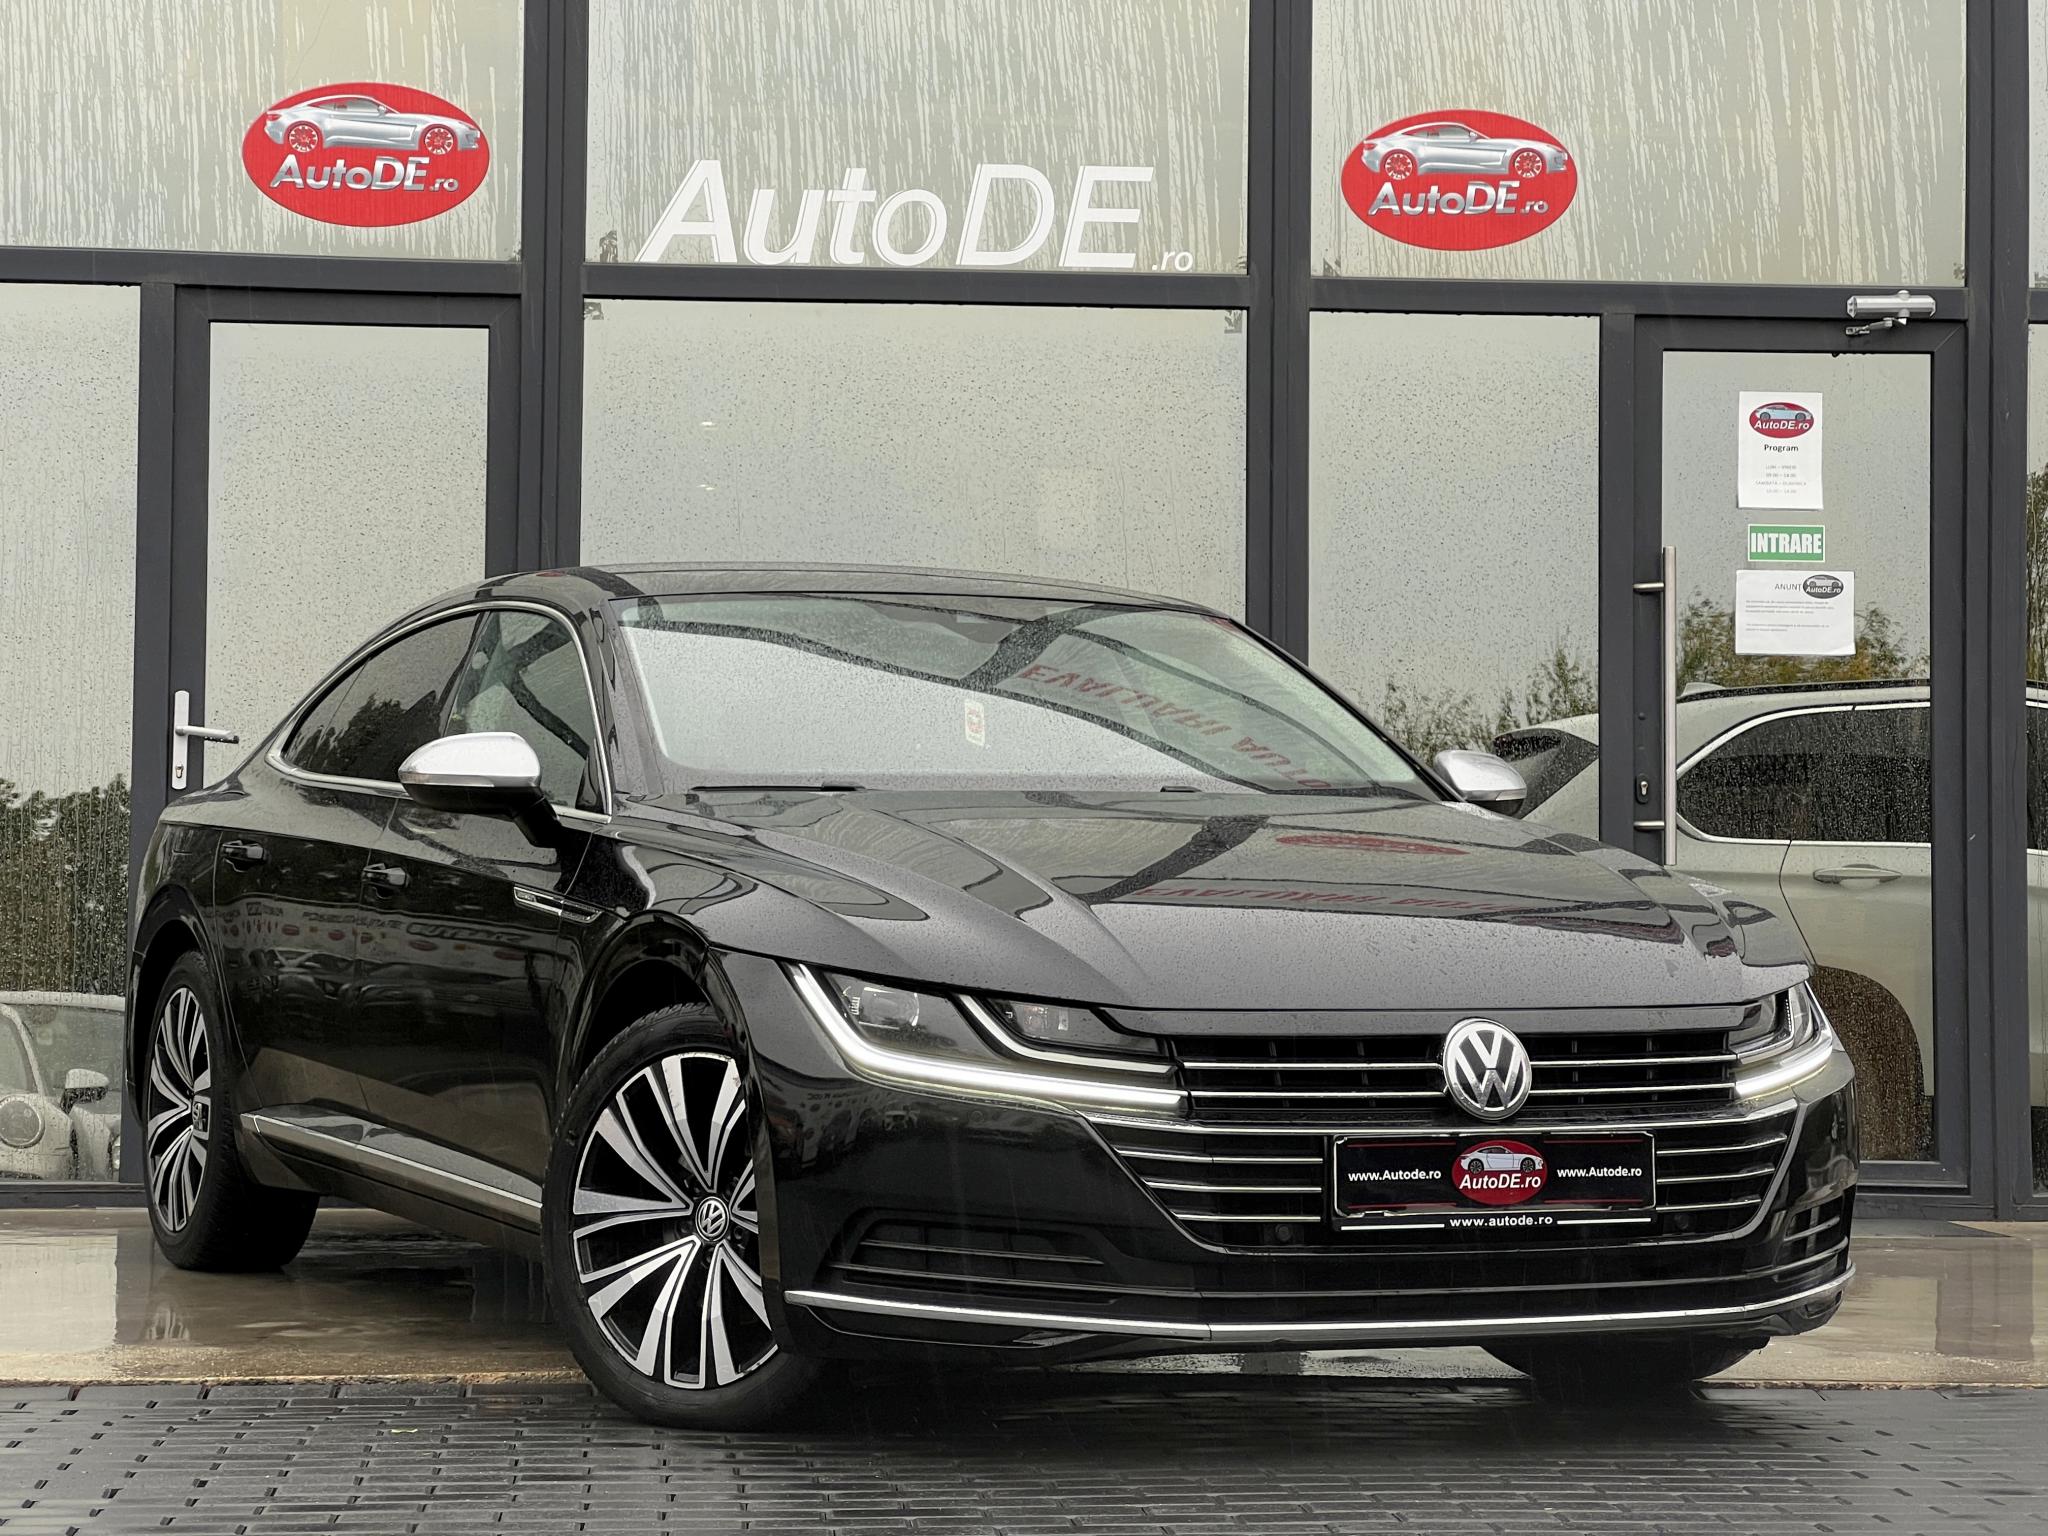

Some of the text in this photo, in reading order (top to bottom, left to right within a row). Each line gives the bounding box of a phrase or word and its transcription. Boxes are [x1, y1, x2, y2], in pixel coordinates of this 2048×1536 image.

[1754, 420, 1810, 430] AutoDE.ro
[1764, 444, 1799, 452] Program
[1751, 532, 1822, 554] INTRARE
[1806, 586, 1841, 594] AutoDE.ro
[1447, 1023, 1527, 1112] VW
[1348, 1168, 1442, 1182] www.Autode.ro
[1556, 1166, 1643, 1178] www.Autode.ro
[1459, 1173, 1542, 1190] AutoDE.ro
[1449, 1215, 1553, 1227] www.autode.ro
